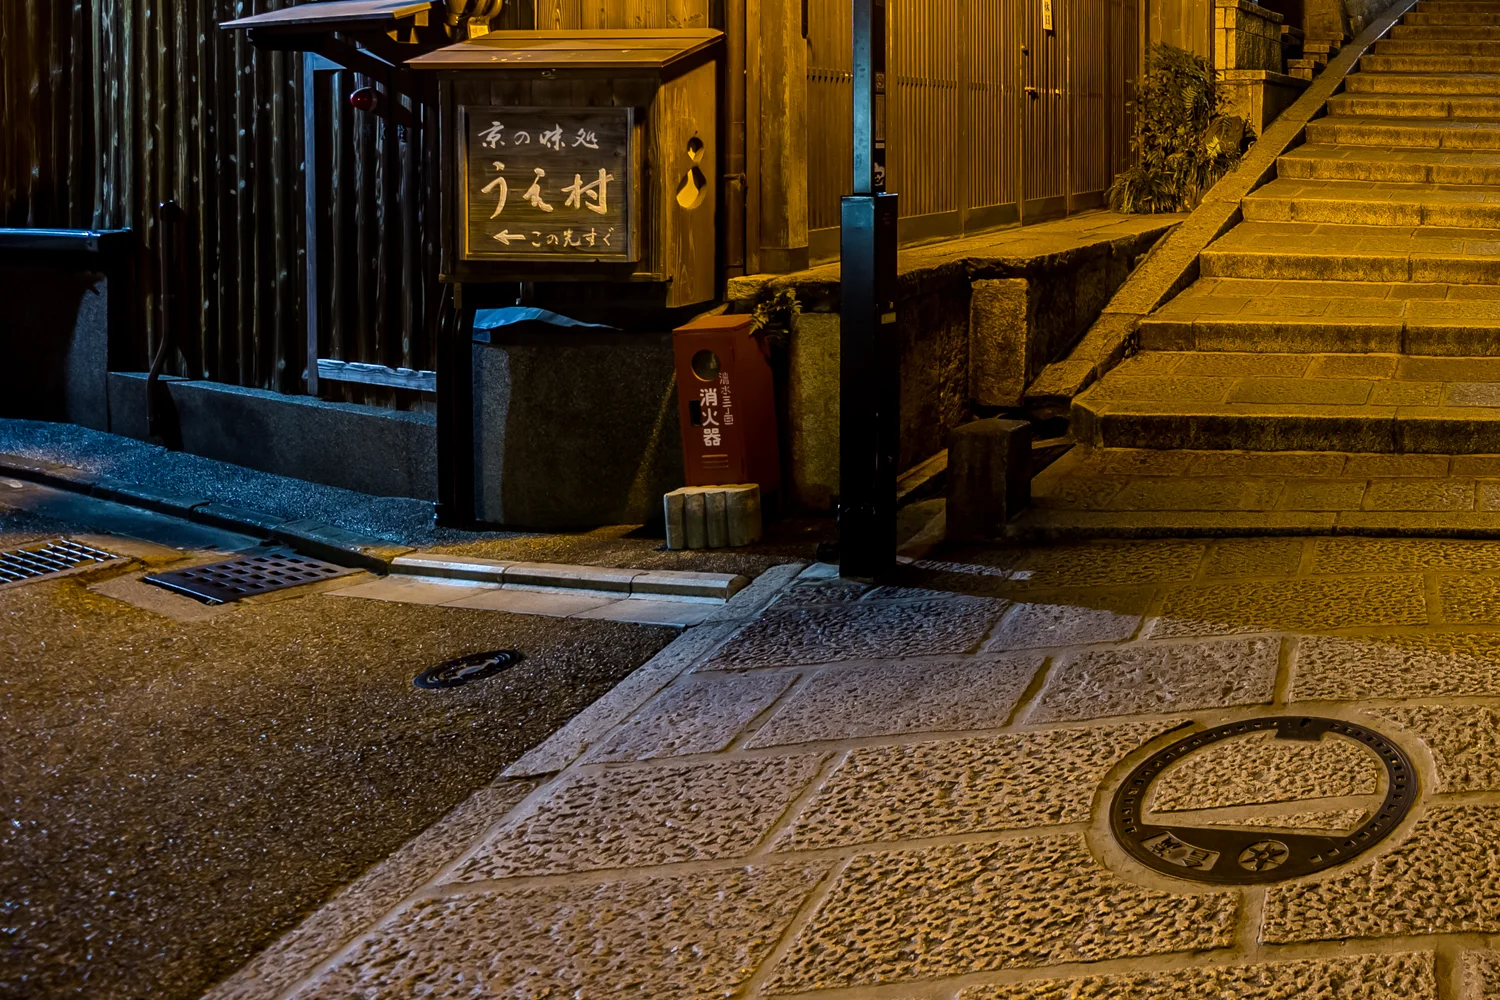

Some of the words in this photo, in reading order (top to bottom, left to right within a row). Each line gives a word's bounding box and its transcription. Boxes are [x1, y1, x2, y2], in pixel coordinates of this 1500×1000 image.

[477, 120, 600, 151] 京の味処
[480, 160, 615, 220] うえ村
[530, 226, 615, 248] この先すぐ
[699, 387, 722, 447] 消火器
[718, 371, 734, 425] 清水三丁目
